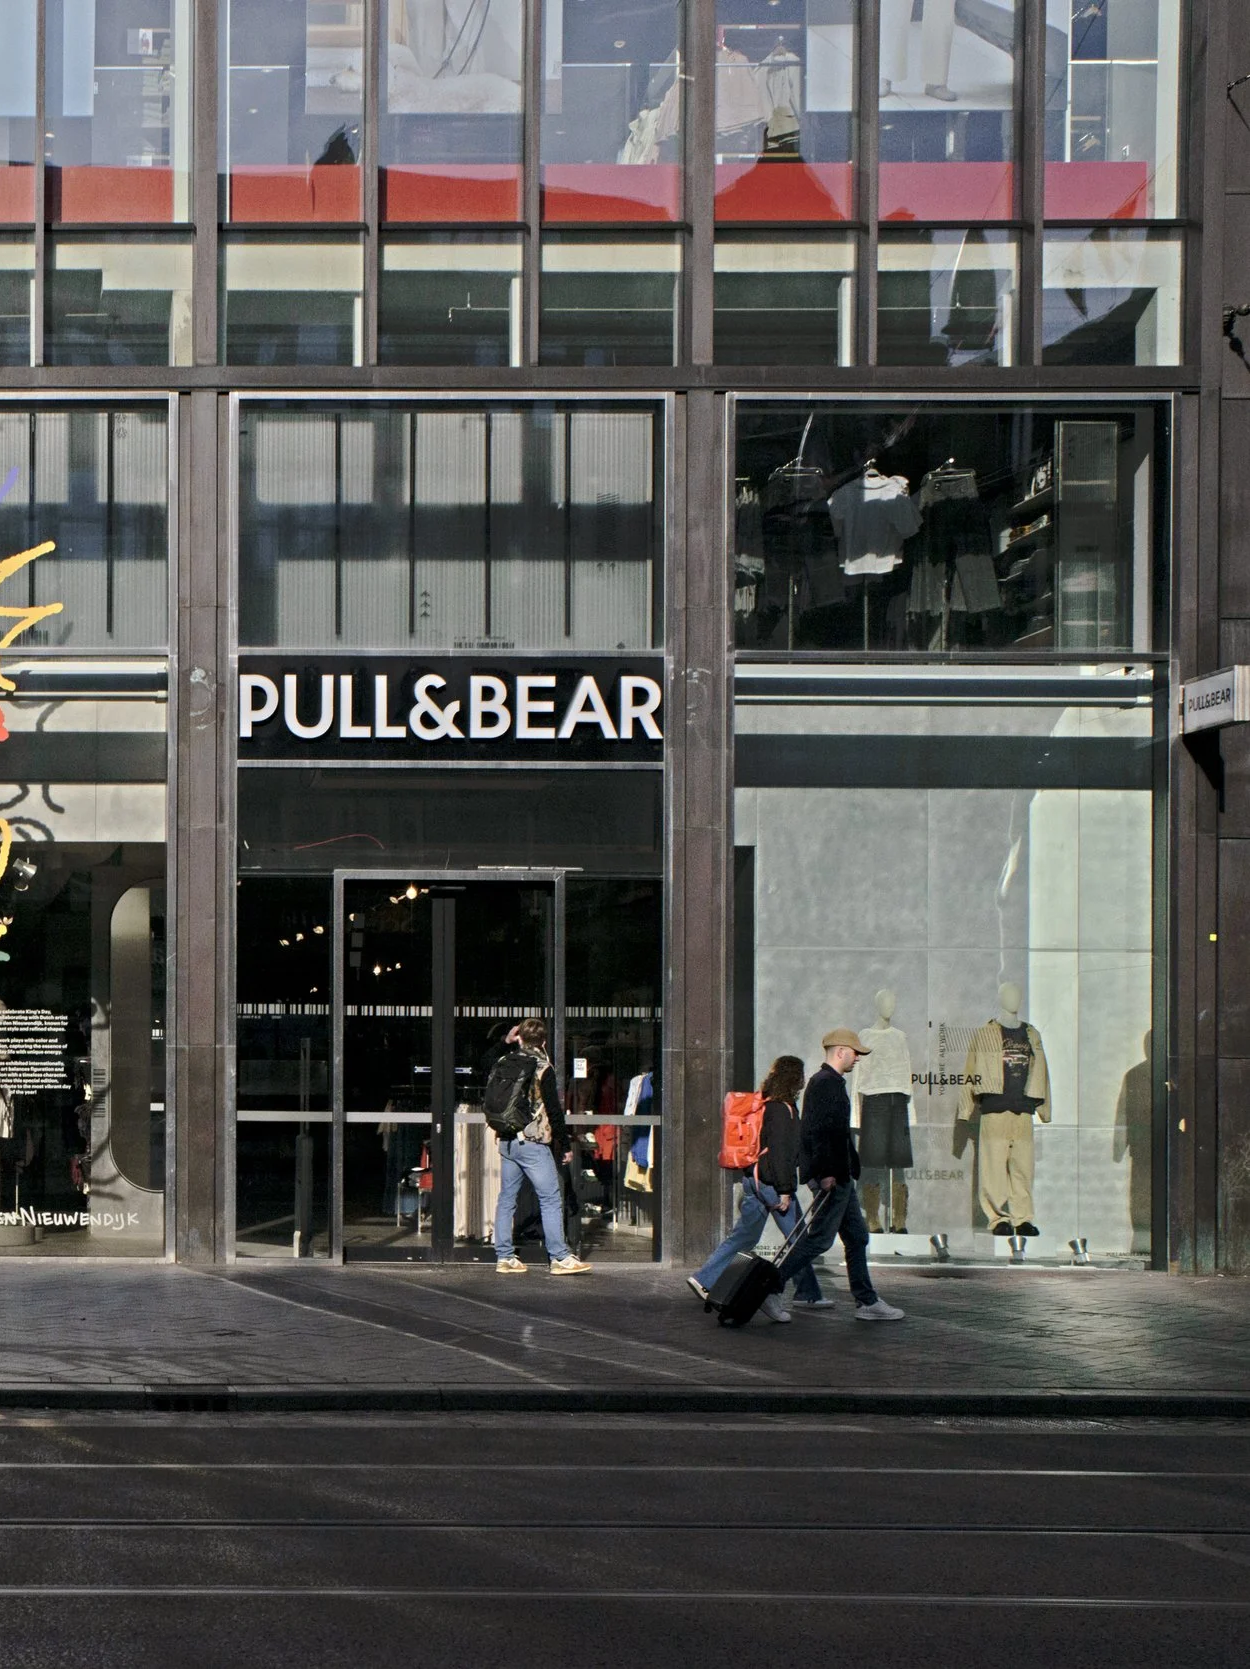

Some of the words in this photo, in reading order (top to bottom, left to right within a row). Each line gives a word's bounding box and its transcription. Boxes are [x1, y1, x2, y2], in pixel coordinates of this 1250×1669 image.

[239, 673, 664, 741] PULL&BEAR
[1188, 687, 1232, 714] PULL&BEAR
[911, 1073, 982, 1086] PULL&BEAR
